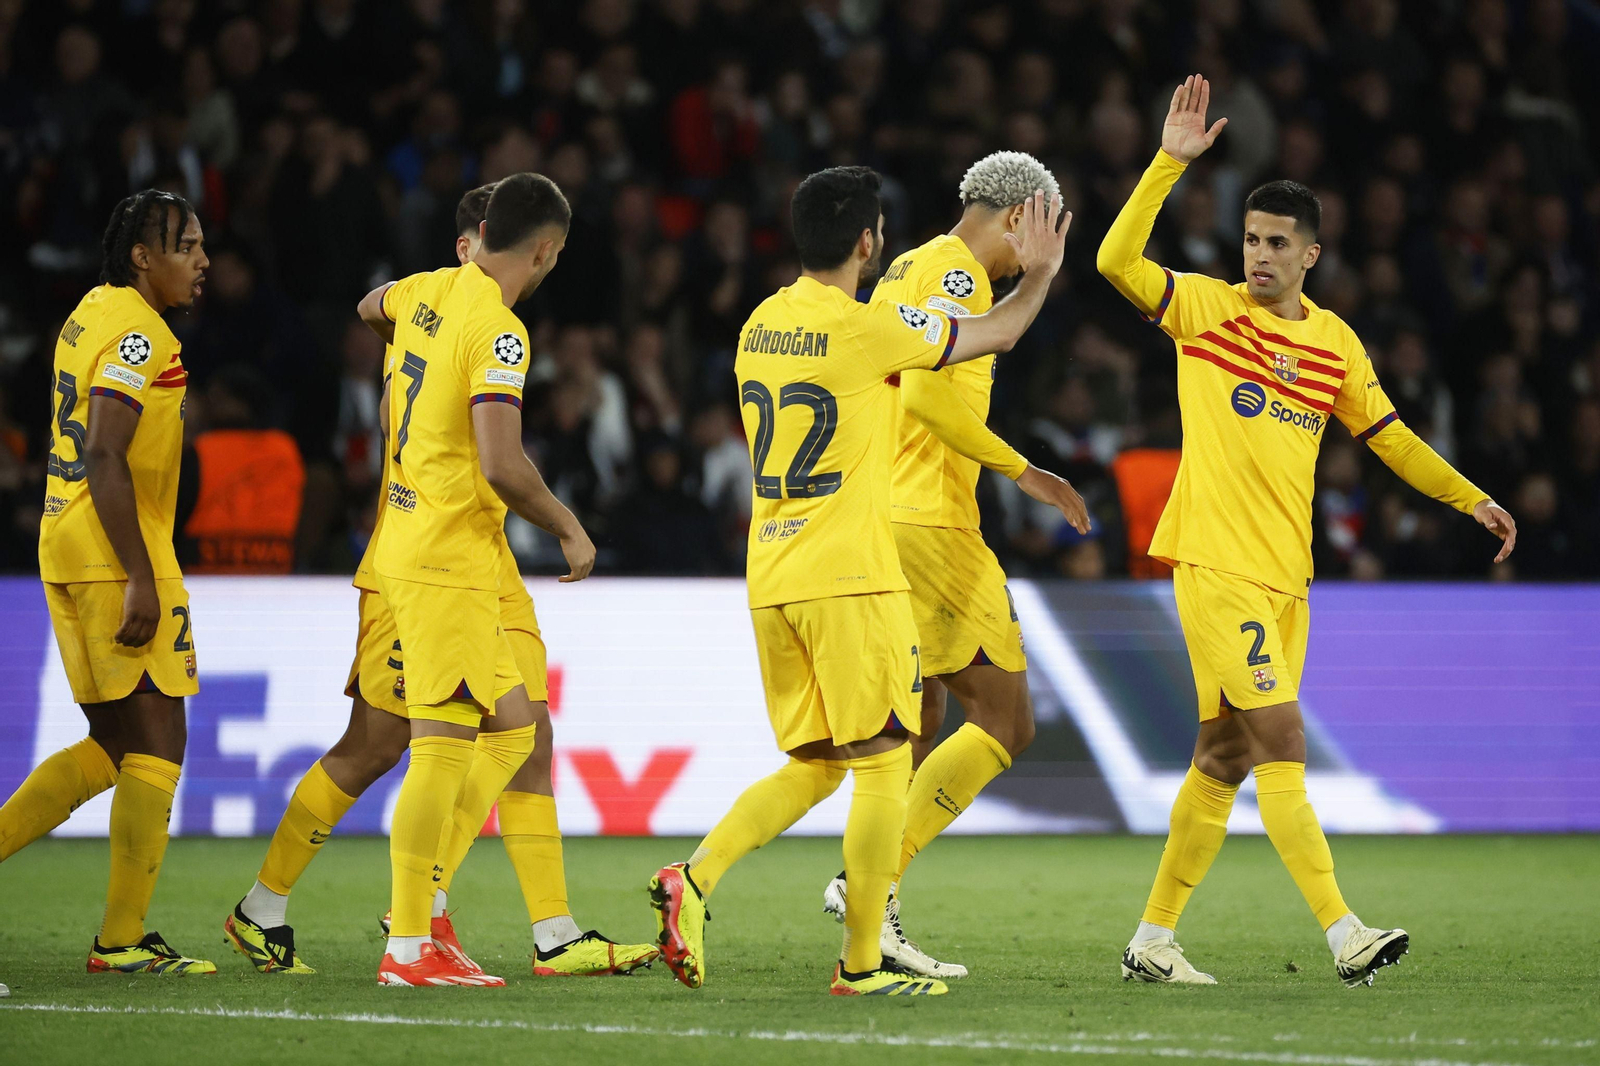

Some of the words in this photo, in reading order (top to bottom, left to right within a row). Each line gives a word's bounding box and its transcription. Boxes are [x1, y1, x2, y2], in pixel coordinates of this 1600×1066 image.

[743, 323, 829, 357] GÜNDOĞAN
[105, 367, 144, 386] FOUNDATION
[393, 350, 427, 465] 7
[1268, 400, 1325, 436] Spotify
[742, 380, 842, 500] 22
[389, 492, 417, 510] CNUR
[172, 605, 195, 652] 2
[1240, 621, 1271, 667] 2
